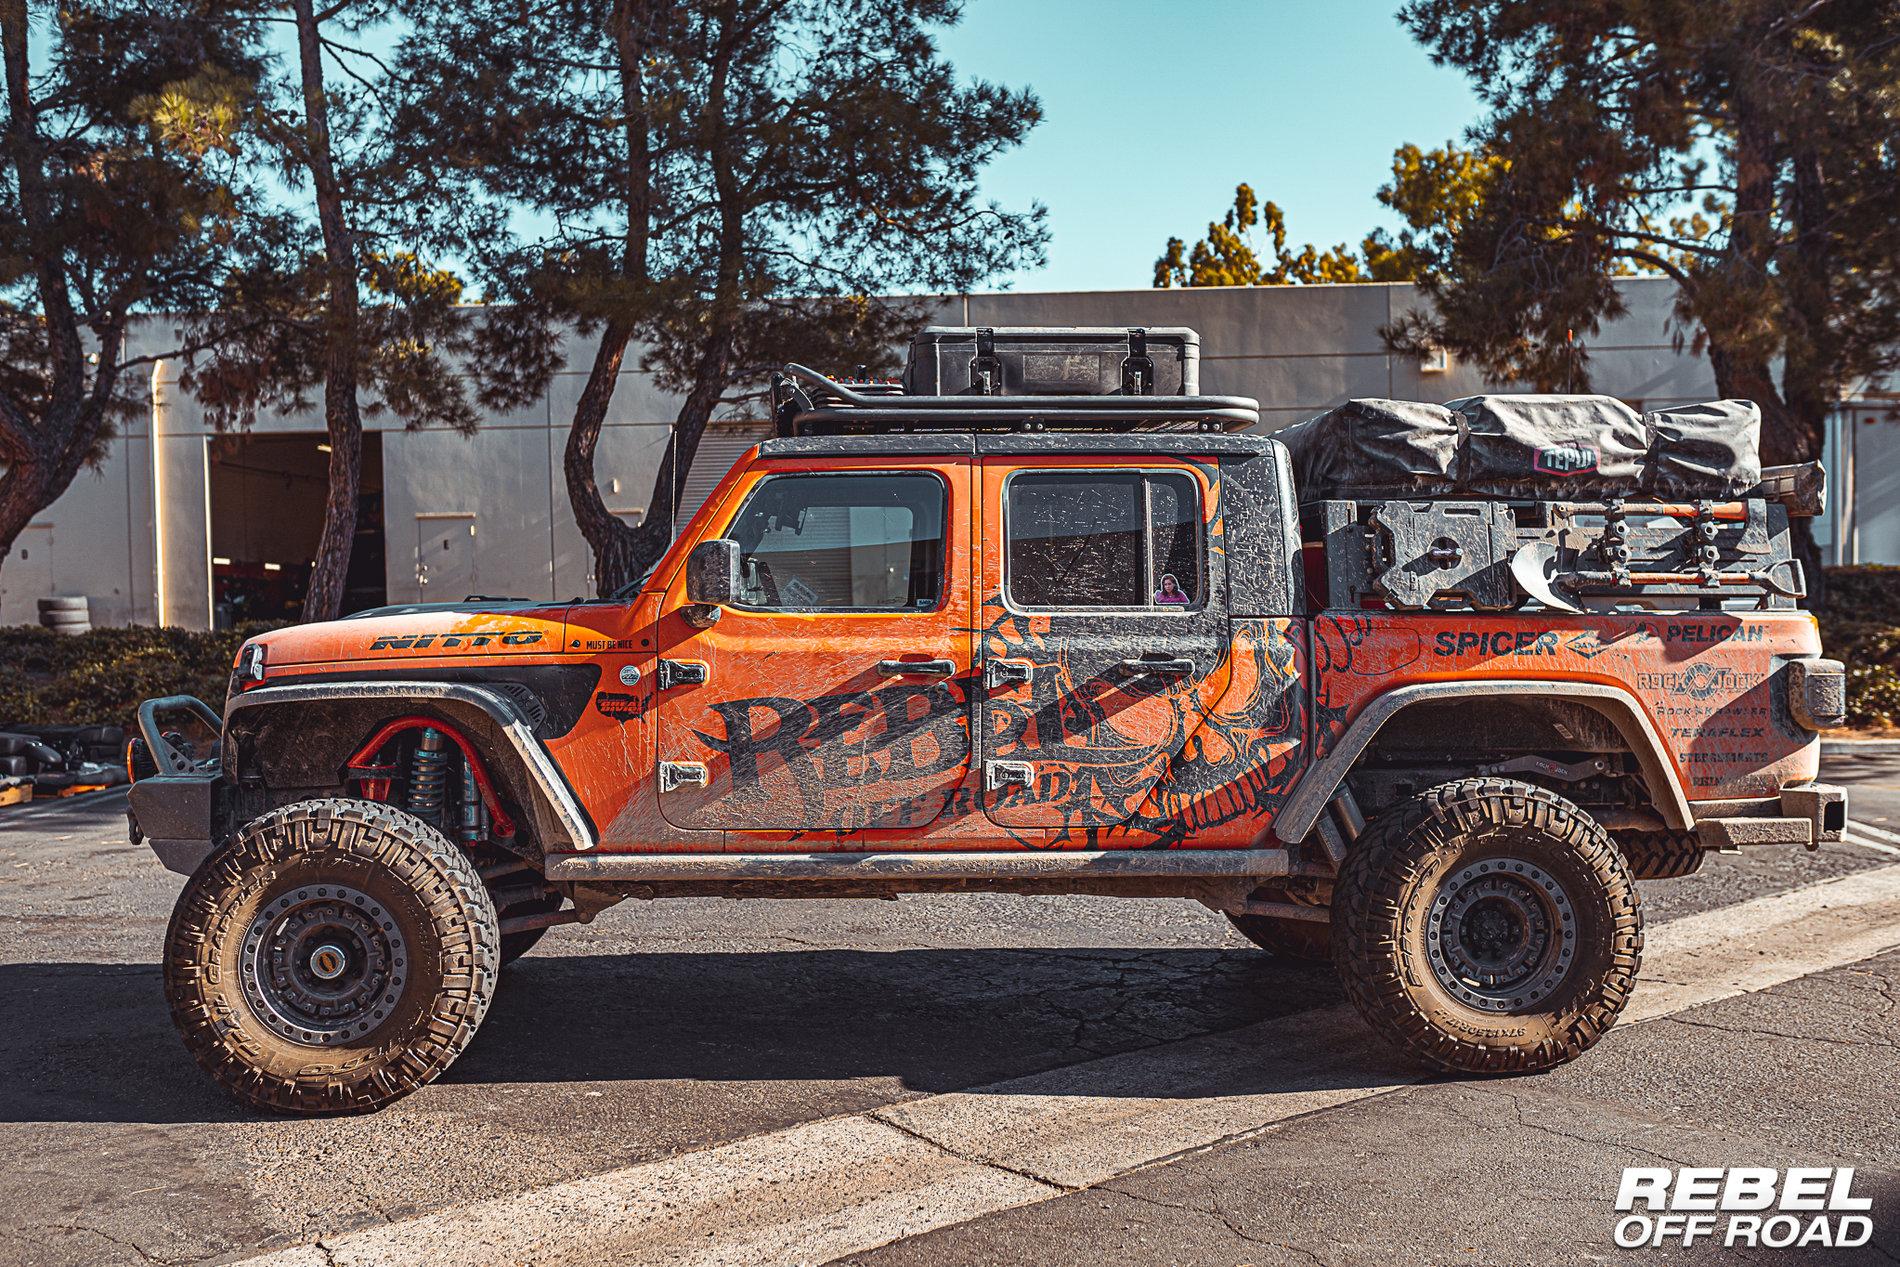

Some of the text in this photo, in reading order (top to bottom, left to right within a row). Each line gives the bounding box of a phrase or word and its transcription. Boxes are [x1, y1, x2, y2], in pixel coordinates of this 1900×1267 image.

[1545, 448, 1593, 471] TEPUI
[369, 631, 543, 651] NITTO
[1666, 625, 1763, 642] PELICAN
[586, 640, 605, 650] MUST
[607, 640, 616, 650] BE
[1434, 631, 1559, 657] SPICER
[1671, 728, 1765, 738] TERAFLEX
